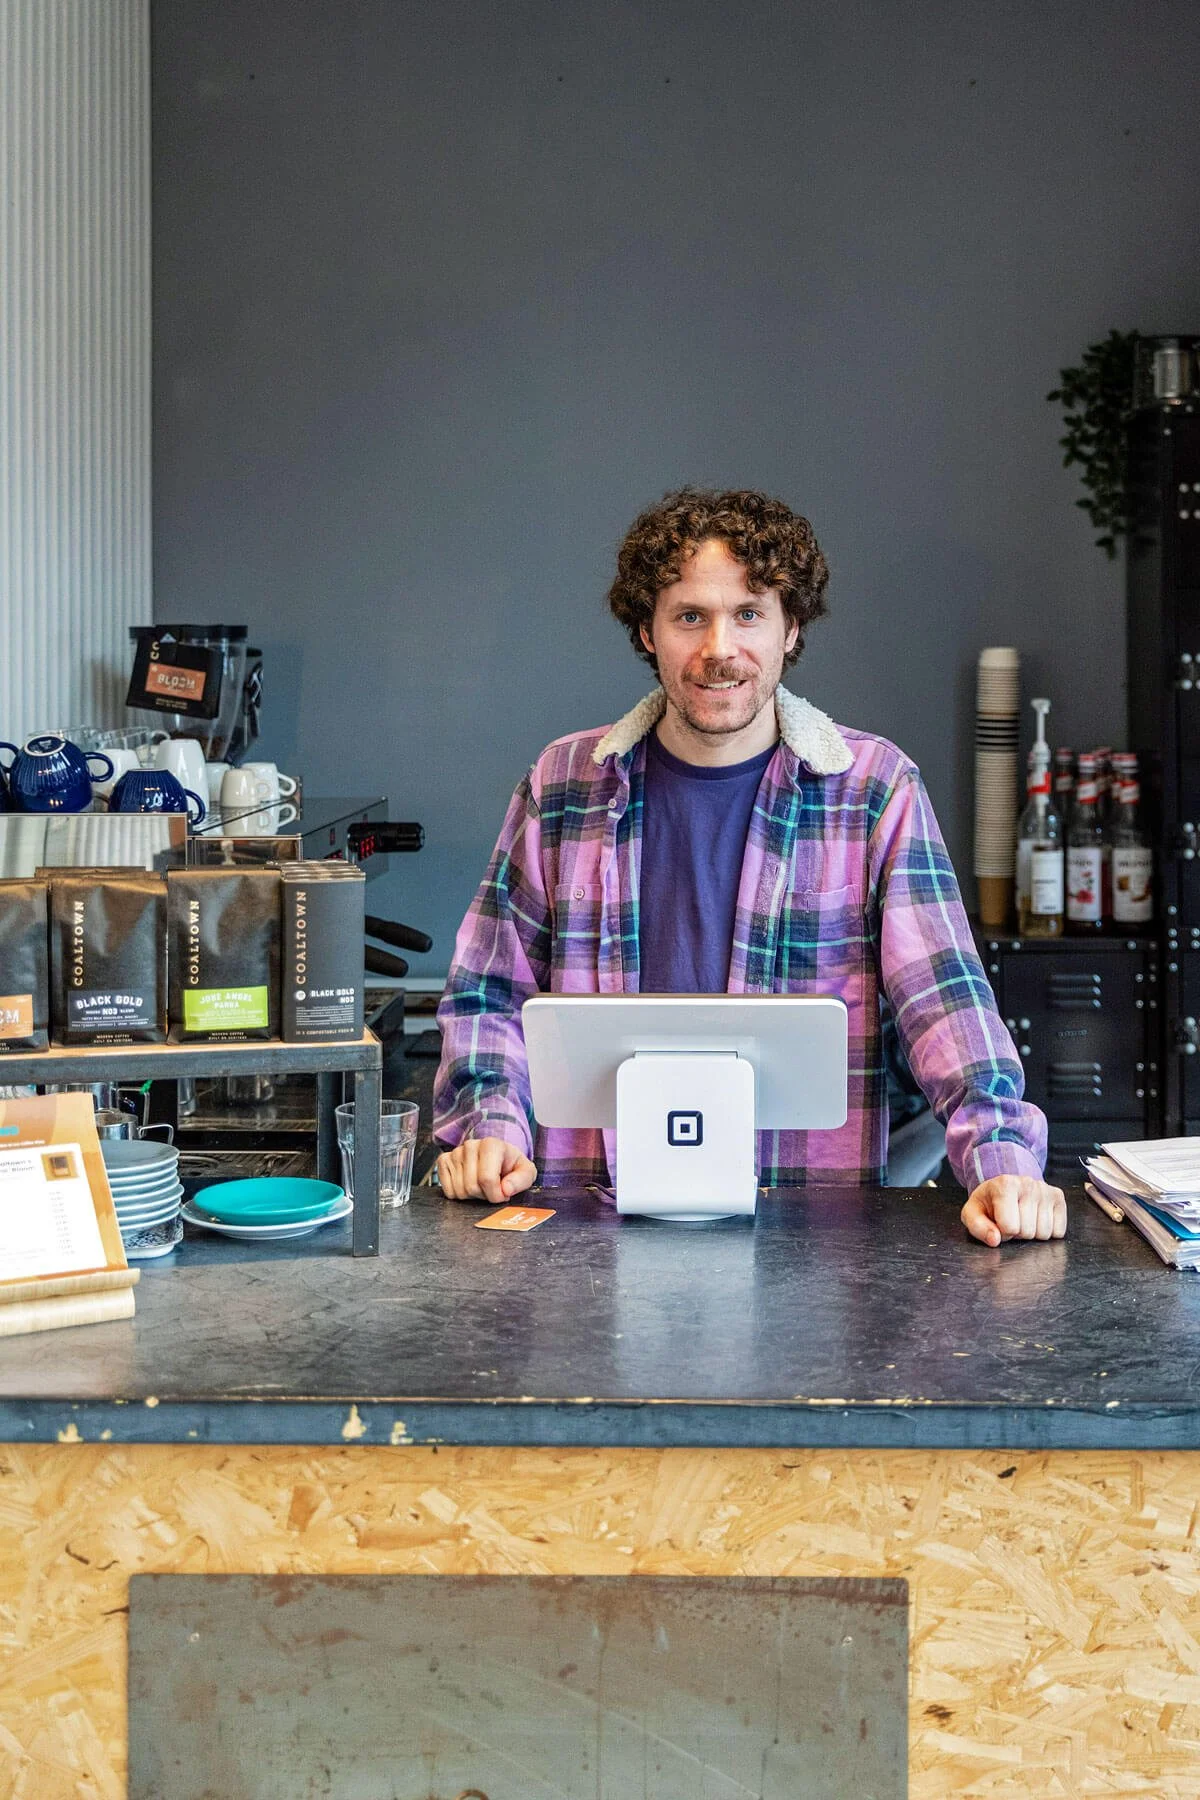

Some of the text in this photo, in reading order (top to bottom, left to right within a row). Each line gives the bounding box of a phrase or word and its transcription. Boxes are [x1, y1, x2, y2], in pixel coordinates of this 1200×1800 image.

[73, 901, 85, 987] COALTOWN
[190, 900, 200, 985] COALTOWN
[295, 891, 307, 985] COALTOWN
[76, 995, 144, 1009] BLACK GOLD
[336, 988, 355, 996] GOLD
